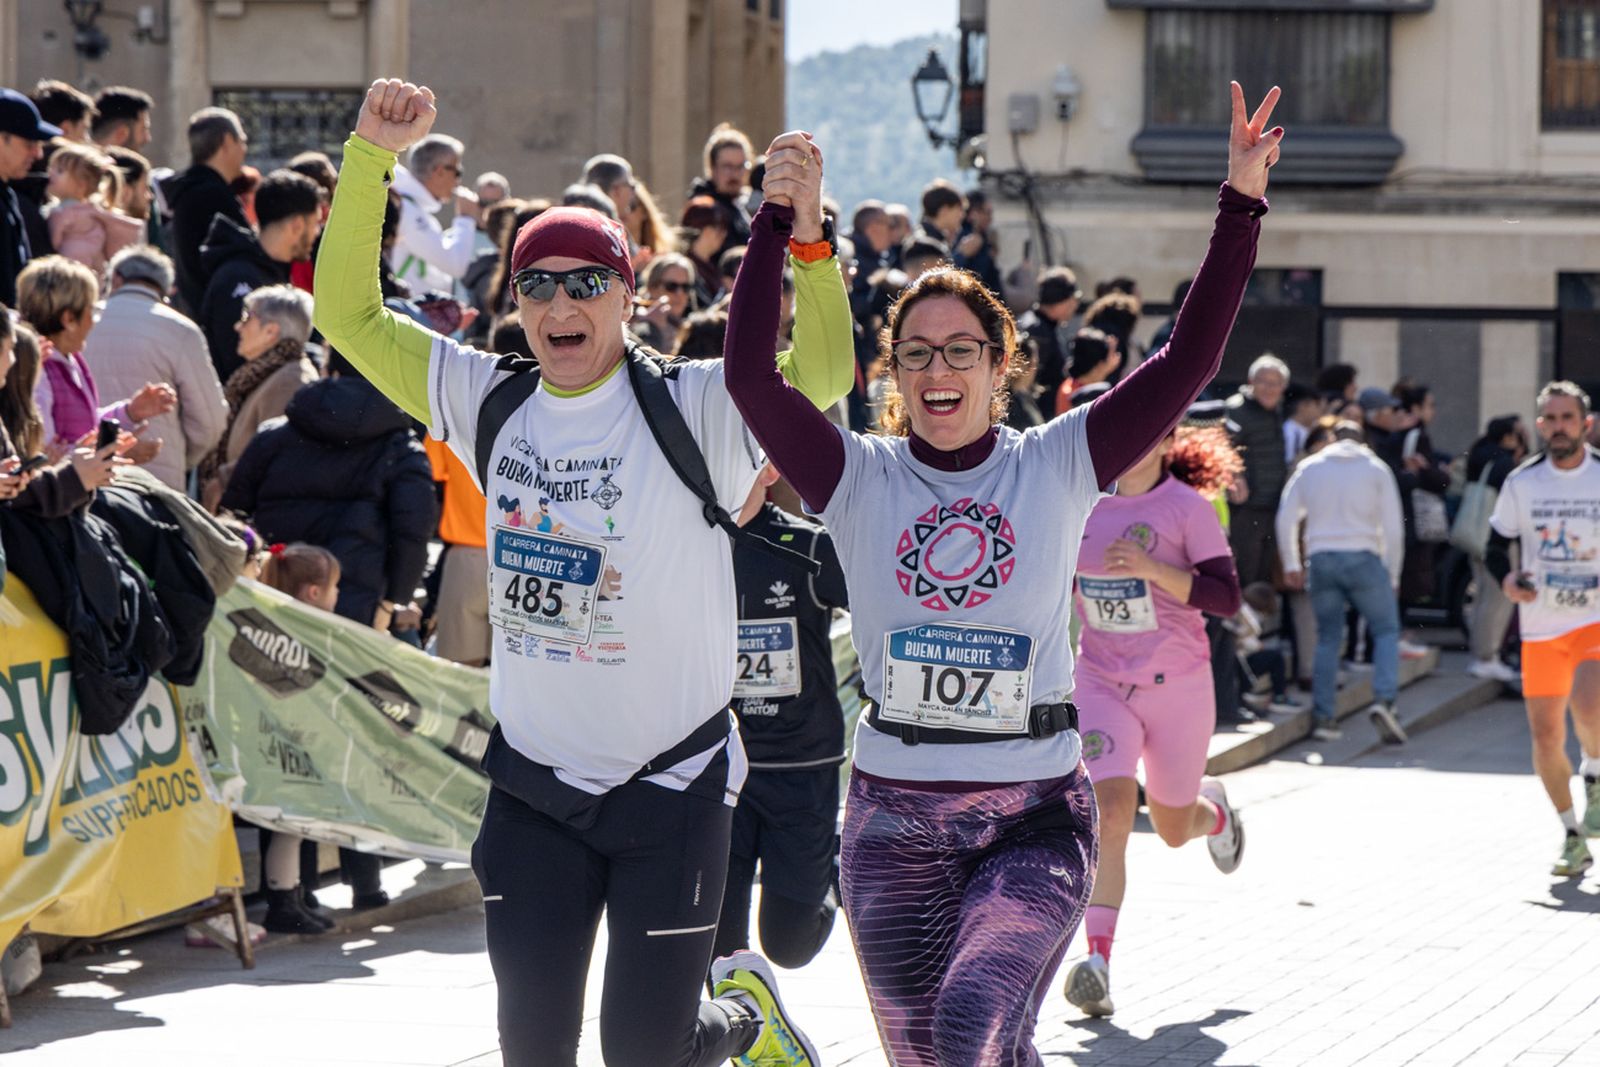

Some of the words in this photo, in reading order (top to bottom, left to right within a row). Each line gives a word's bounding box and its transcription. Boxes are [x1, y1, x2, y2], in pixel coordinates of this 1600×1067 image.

[534, 472, 590, 502] MUERTE
[509, 537, 541, 552] CARRERA
[543, 544, 588, 561] CAMINATA
[501, 549, 522, 569] BUENA
[524, 555, 566, 576] MUERTE
[504, 574, 564, 618] 485
[1095, 600, 1130, 620] 193
[744, 625, 782, 636] CAMINATA
[907, 628, 917, 637] VI
[920, 628, 963, 642] CARRERA
[965, 633, 1016, 646] CAMINATA
[904, 641, 942, 660] BUENA
[945, 646, 992, 665] MUERTE
[920, 664, 995, 707] 107
